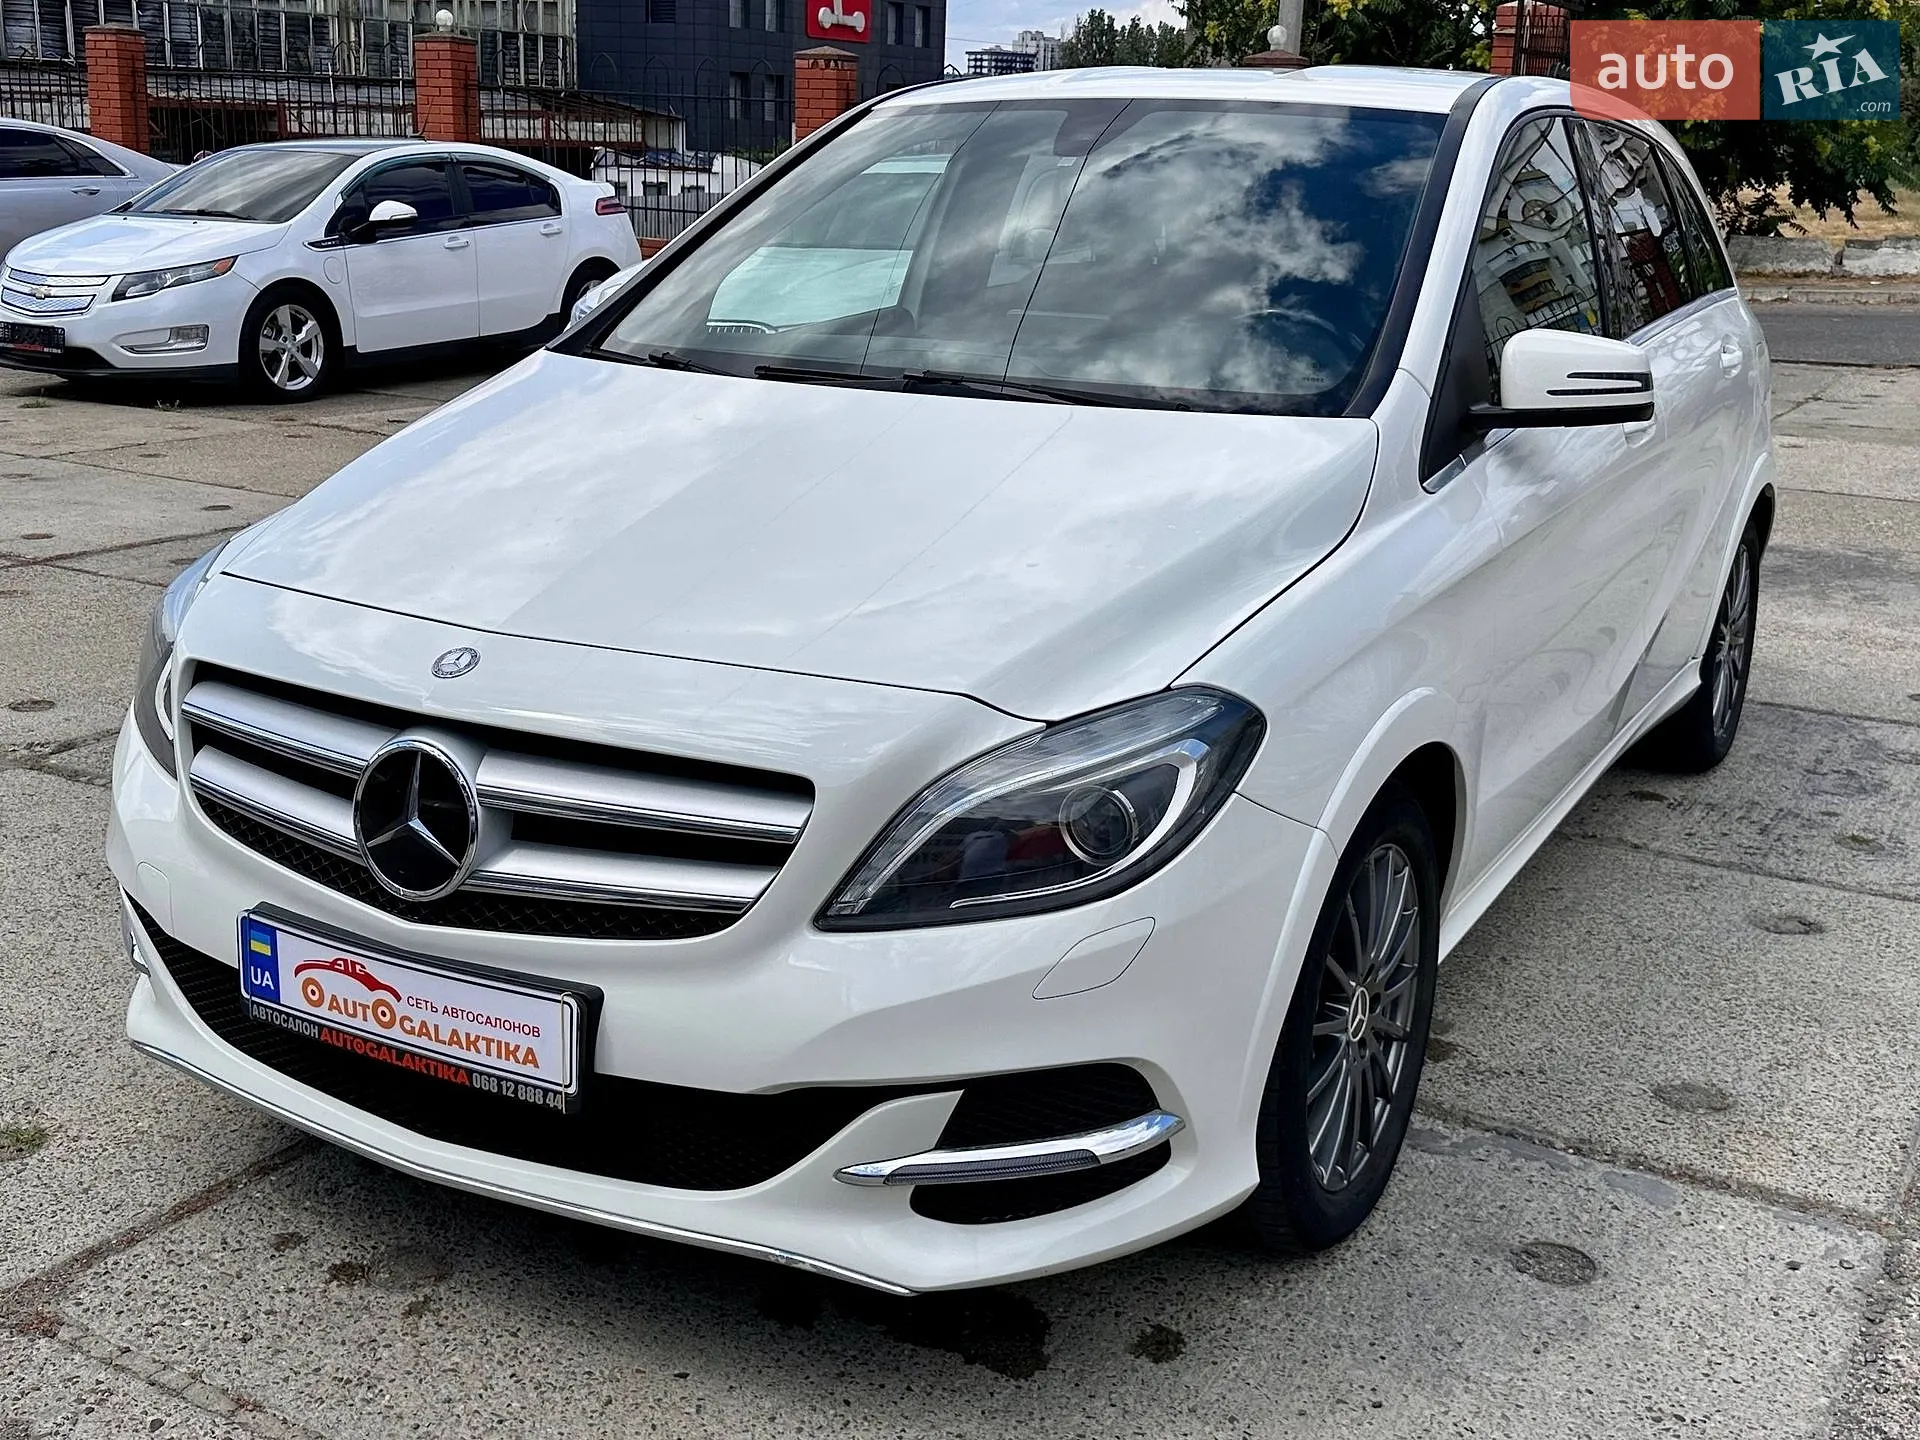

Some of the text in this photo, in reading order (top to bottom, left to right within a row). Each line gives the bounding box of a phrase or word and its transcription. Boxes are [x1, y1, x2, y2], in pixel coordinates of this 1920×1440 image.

[251, 966, 274, 990] UA
[407, 996, 541, 1038] СЕТЬ АВТОСАЛОНОВ
[252, 1004, 562, 1109] АВТОСАЛОН AUTOGALAKTIKA 068 12 888 44
